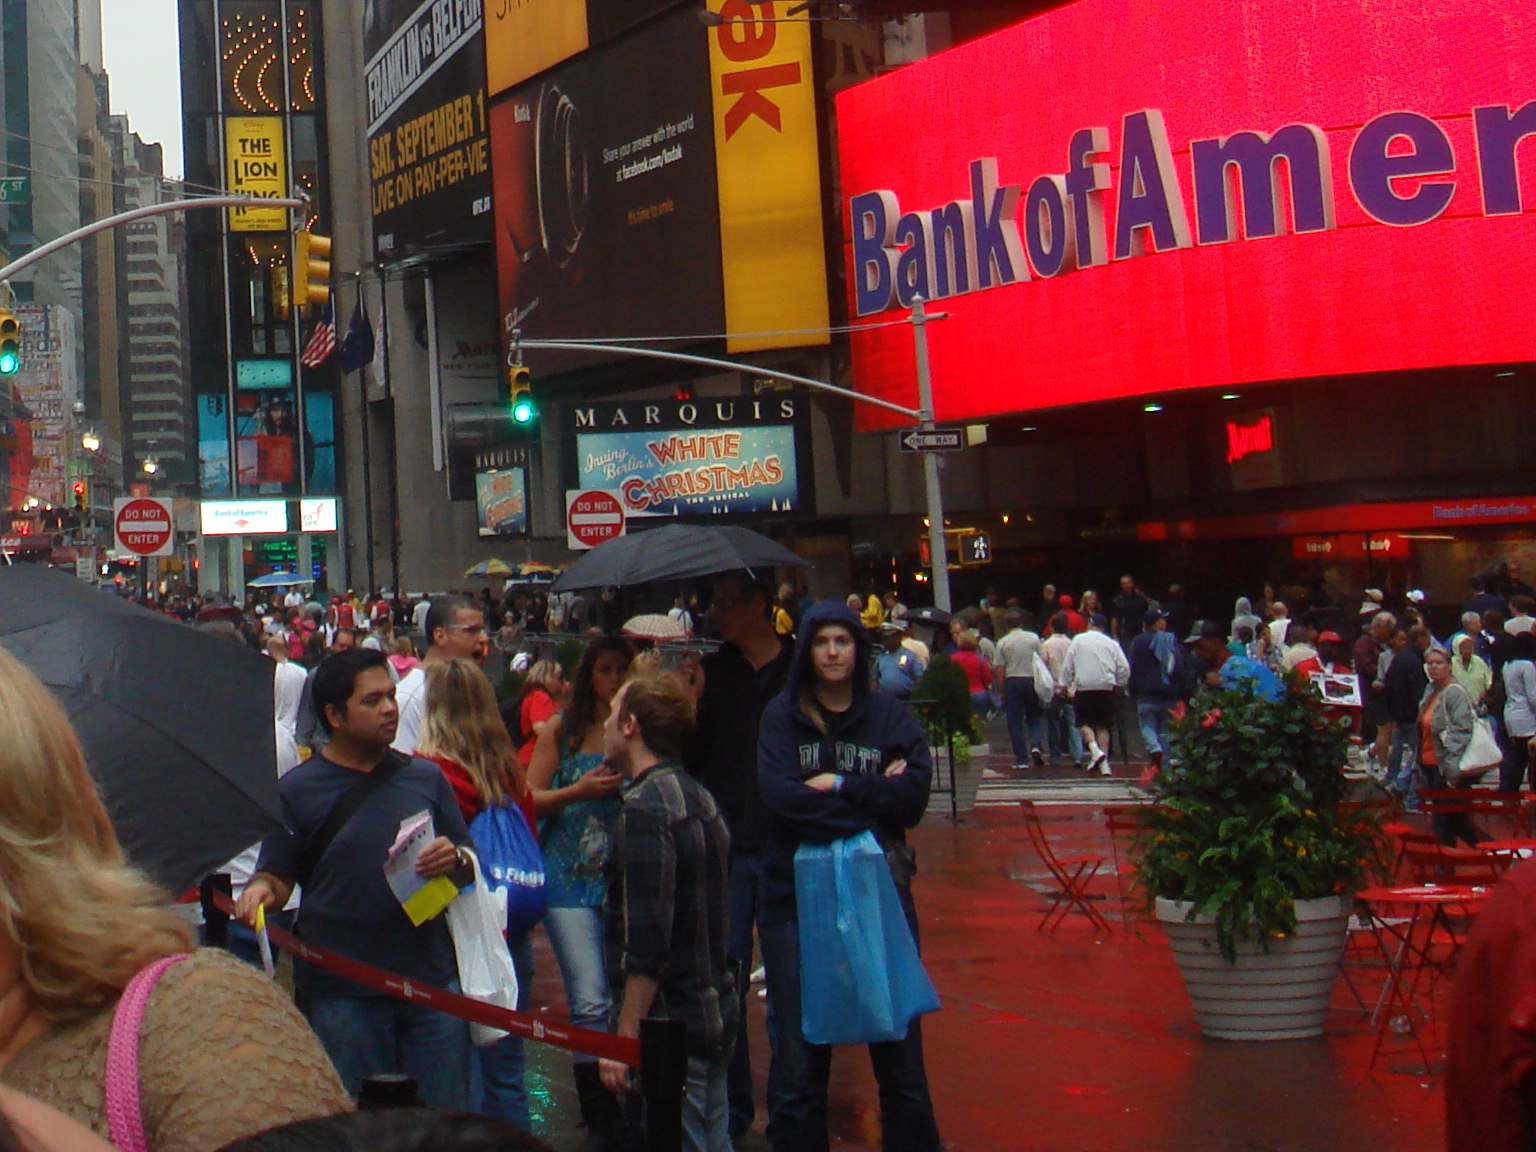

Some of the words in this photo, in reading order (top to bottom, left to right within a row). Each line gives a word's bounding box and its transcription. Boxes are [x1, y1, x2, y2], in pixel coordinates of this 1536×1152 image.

[367, 22, 421, 124] FRANKLIN
[396, 94, 474, 168] SEPTEMBER
[619, 143, 631, 160] your
[665, 122, 677, 139] the
[238, 137, 271, 154] THE
[234, 159, 278, 186] LION
[11, 181, 23, 191] ST
[372, 179, 395, 215] LIVE
[396, 171, 414, 206] ON
[849, 157, 1031, 317] Bank
[1022, 127, 1110, 278] of
[1112, 101, 1536, 263] Amer
[574, 399, 794, 428] MARQUIS
[646, 431, 742, 467] WHITE
[909, 437, 926, 445] ONE
[475, 449, 526, 469] MARQUIS
[584, 448, 630, 473] Irving
[602, 454, 654, 481] Berlin's
[620, 454, 783, 511] CHRISTMAS
[576, 501, 592, 512] DO
[594, 501, 614, 511] NOT
[686, 497, 703, 505] THE
[708, 491, 750, 502] MUSICAL
[125, 509, 140, 519] DO
[142, 509, 161, 518] NOT
[1432, 504, 1463, 519] Bank
[1466, 504, 1478, 517] of
[1479, 503, 1530, 517] America
[128, 534, 159, 544] ENTER
[580, 526, 613, 537] ENTER
